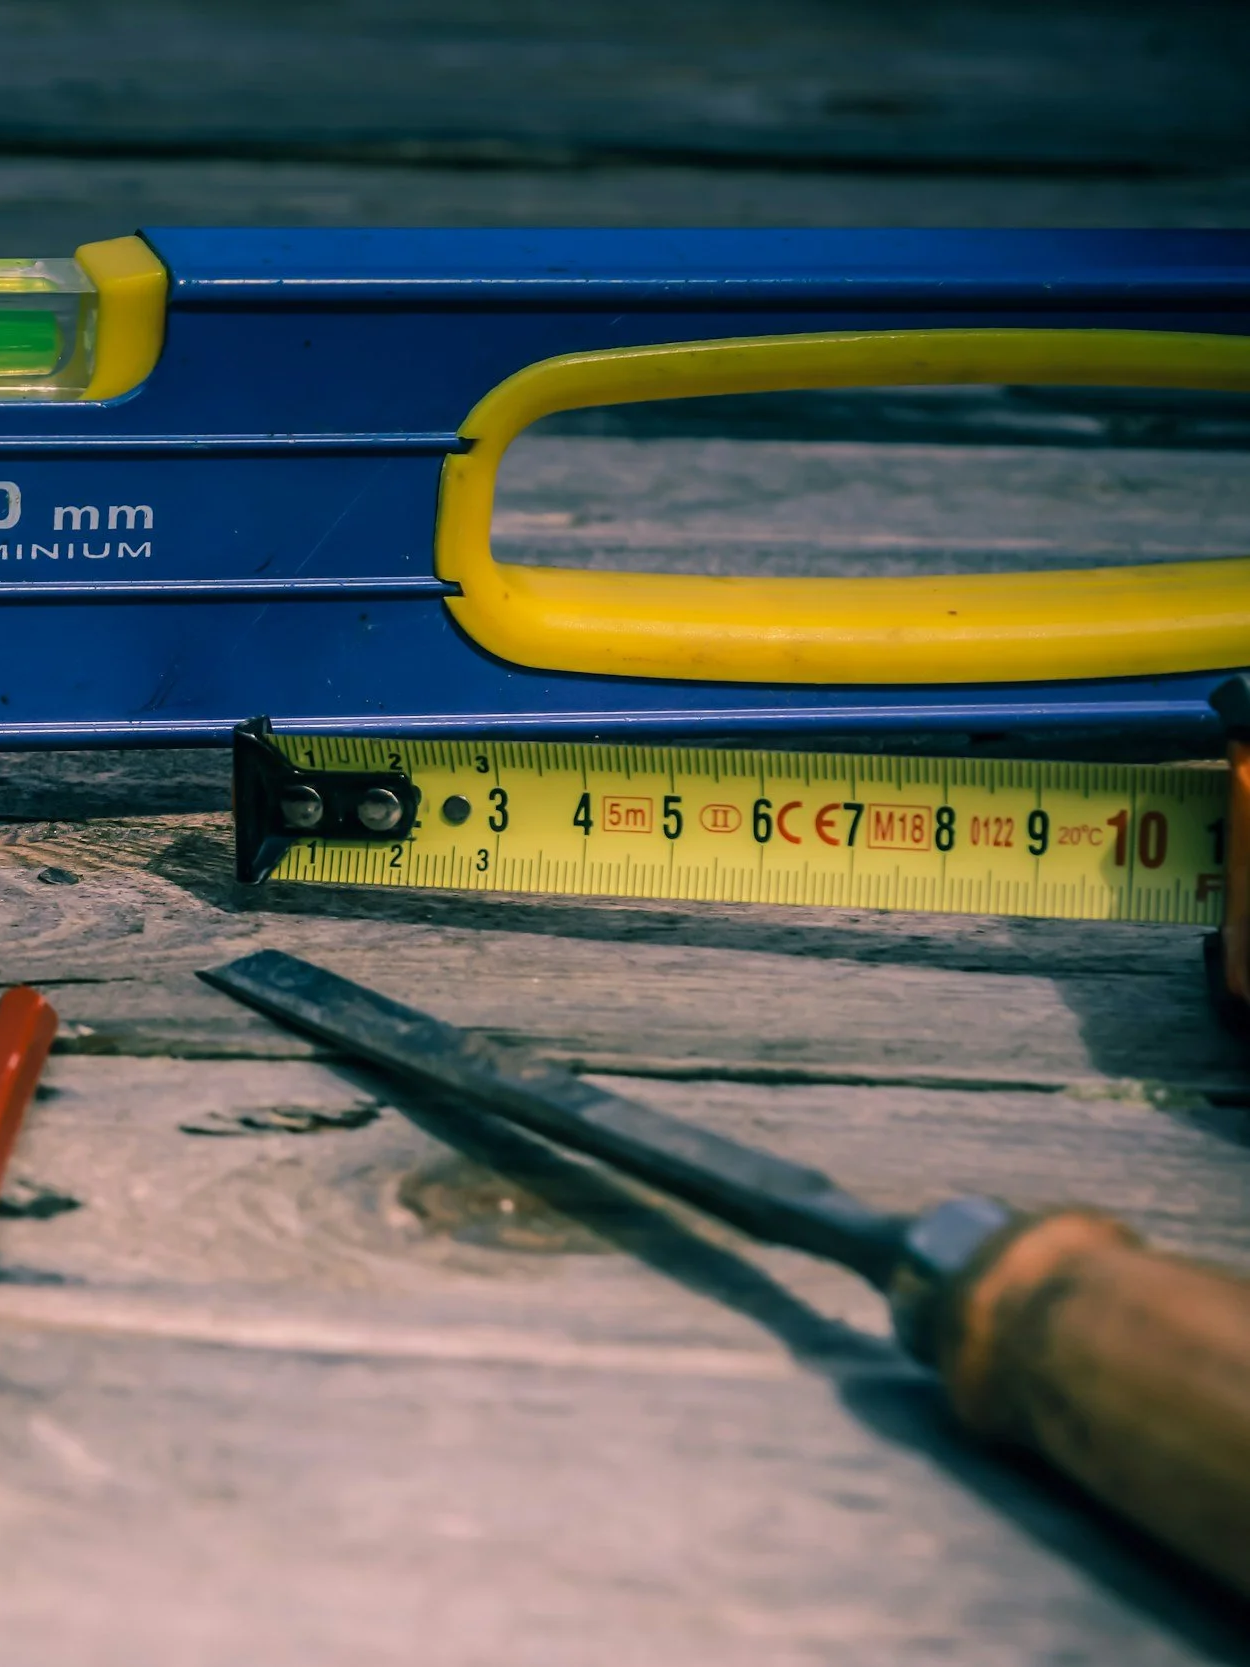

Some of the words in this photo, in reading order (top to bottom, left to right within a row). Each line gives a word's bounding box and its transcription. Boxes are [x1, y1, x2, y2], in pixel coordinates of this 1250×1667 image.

[53, 503, 153, 530] mm
[304, 751, 315, 767] 1
[388, 753, 403, 770] 2
[476, 756, 489, 773] 3
[488, 788, 509, 832] 3
[573, 792, 593, 836] 4
[608, 803, 646, 827] 5m
[663, 796, 683, 840] 5
[753, 798, 773, 843] 6
[843, 803, 865, 846] 7
[874, 810, 926, 843] M18
[935, 806, 955, 851] 8
[970, 816, 1014, 847] 0122
[1028, 809, 1049, 856] 9
[1107, 809, 1168, 869] 10
[307, 841, 317, 864] 1
[390, 844, 403, 868] 2
[476, 849, 489, 871] 3
